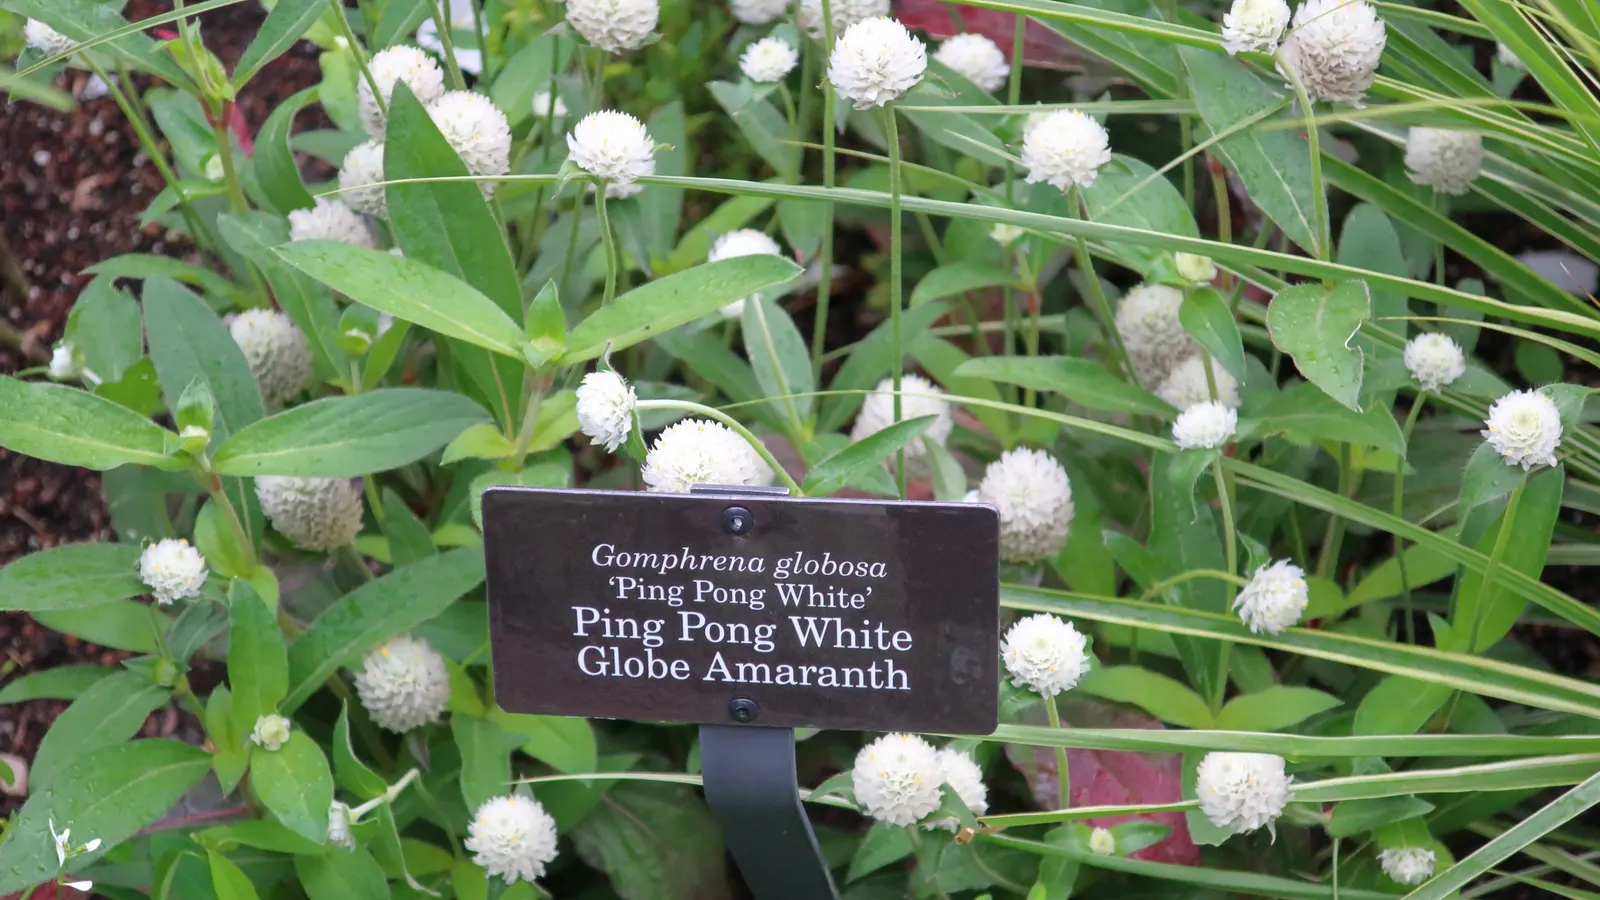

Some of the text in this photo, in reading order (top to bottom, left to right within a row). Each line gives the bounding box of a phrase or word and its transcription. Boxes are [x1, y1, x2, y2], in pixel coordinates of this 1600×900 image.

[591, 543, 888, 580] Gomphrena globosa
[608, 575, 874, 611] ‘Ping Pong White’
[571, 605, 913, 653] Ping Pong White
[577, 645, 912, 691] Globe Amaranth
